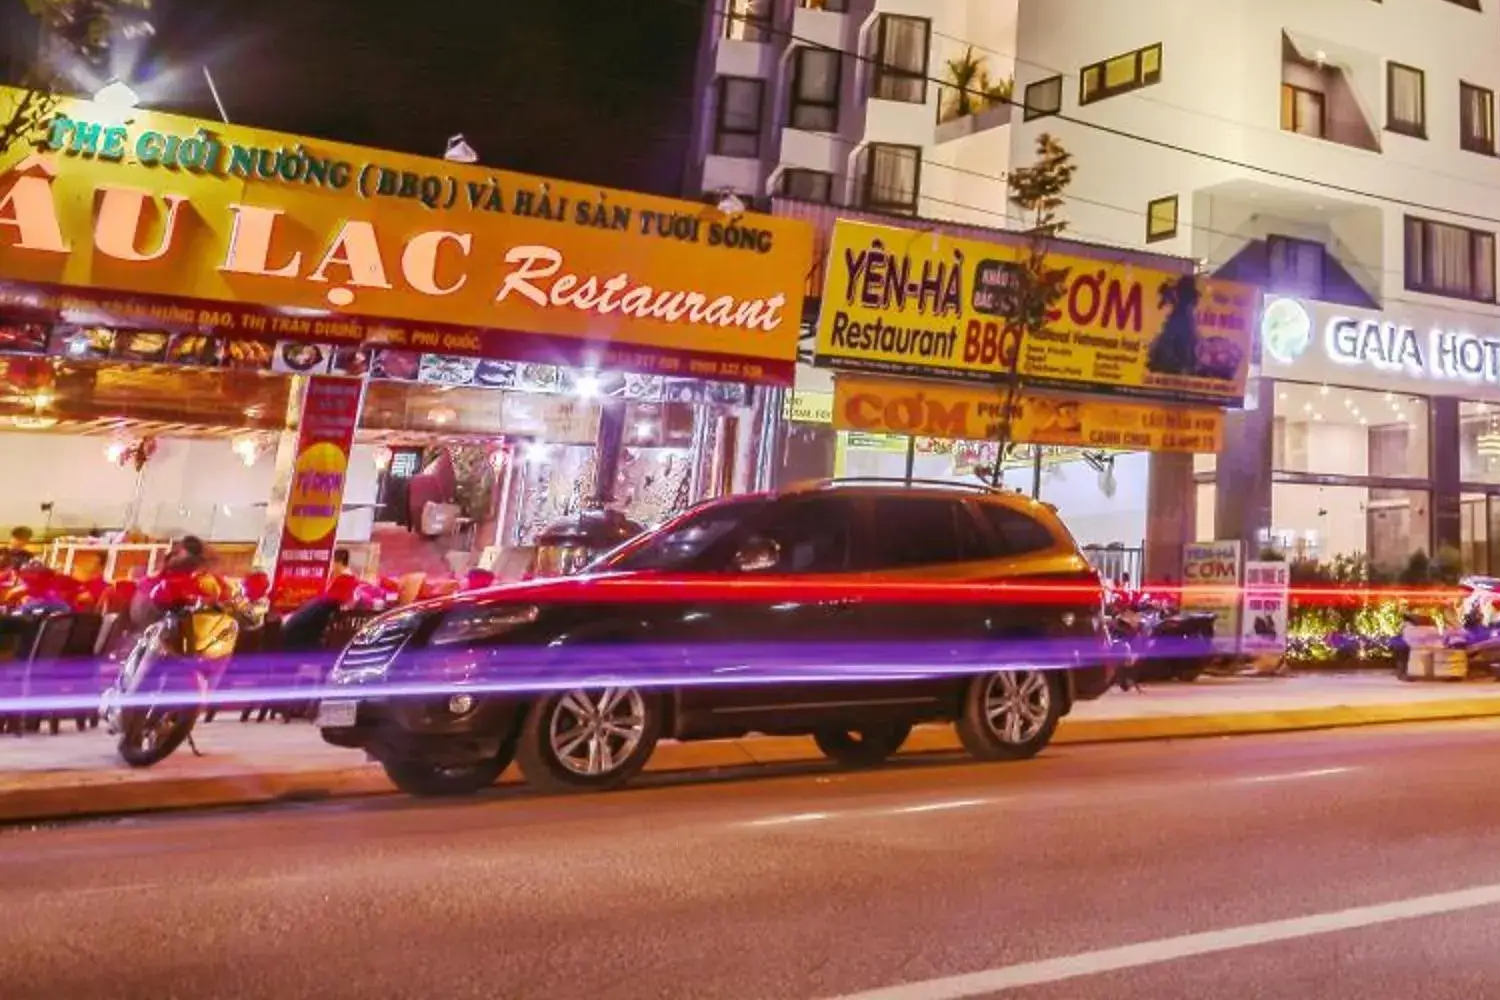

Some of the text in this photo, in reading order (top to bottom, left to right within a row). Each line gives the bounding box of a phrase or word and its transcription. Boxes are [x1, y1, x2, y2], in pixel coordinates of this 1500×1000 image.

[136, 125, 221, 173] GIỚI
[227, 144, 353, 190] NƯỚNG
[466, 166, 506, 213] VÀ
[513, 182, 565, 223] HẢI
[575, 199, 630, 234] SẢN
[639, 209, 700, 243] TƯƠI
[708, 215, 773, 255] SỐNG
[215, 202, 473, 306] LẠC
[496, 244, 787, 332] Restaurant
[830, 311, 958, 360] Restaurant
[962, 319, 1024, 368] BBQ
[1331, 317, 1424, 368] GAIA
[844, 390, 969, 435] CƠM
[977, 401, 1024, 421] PHN
